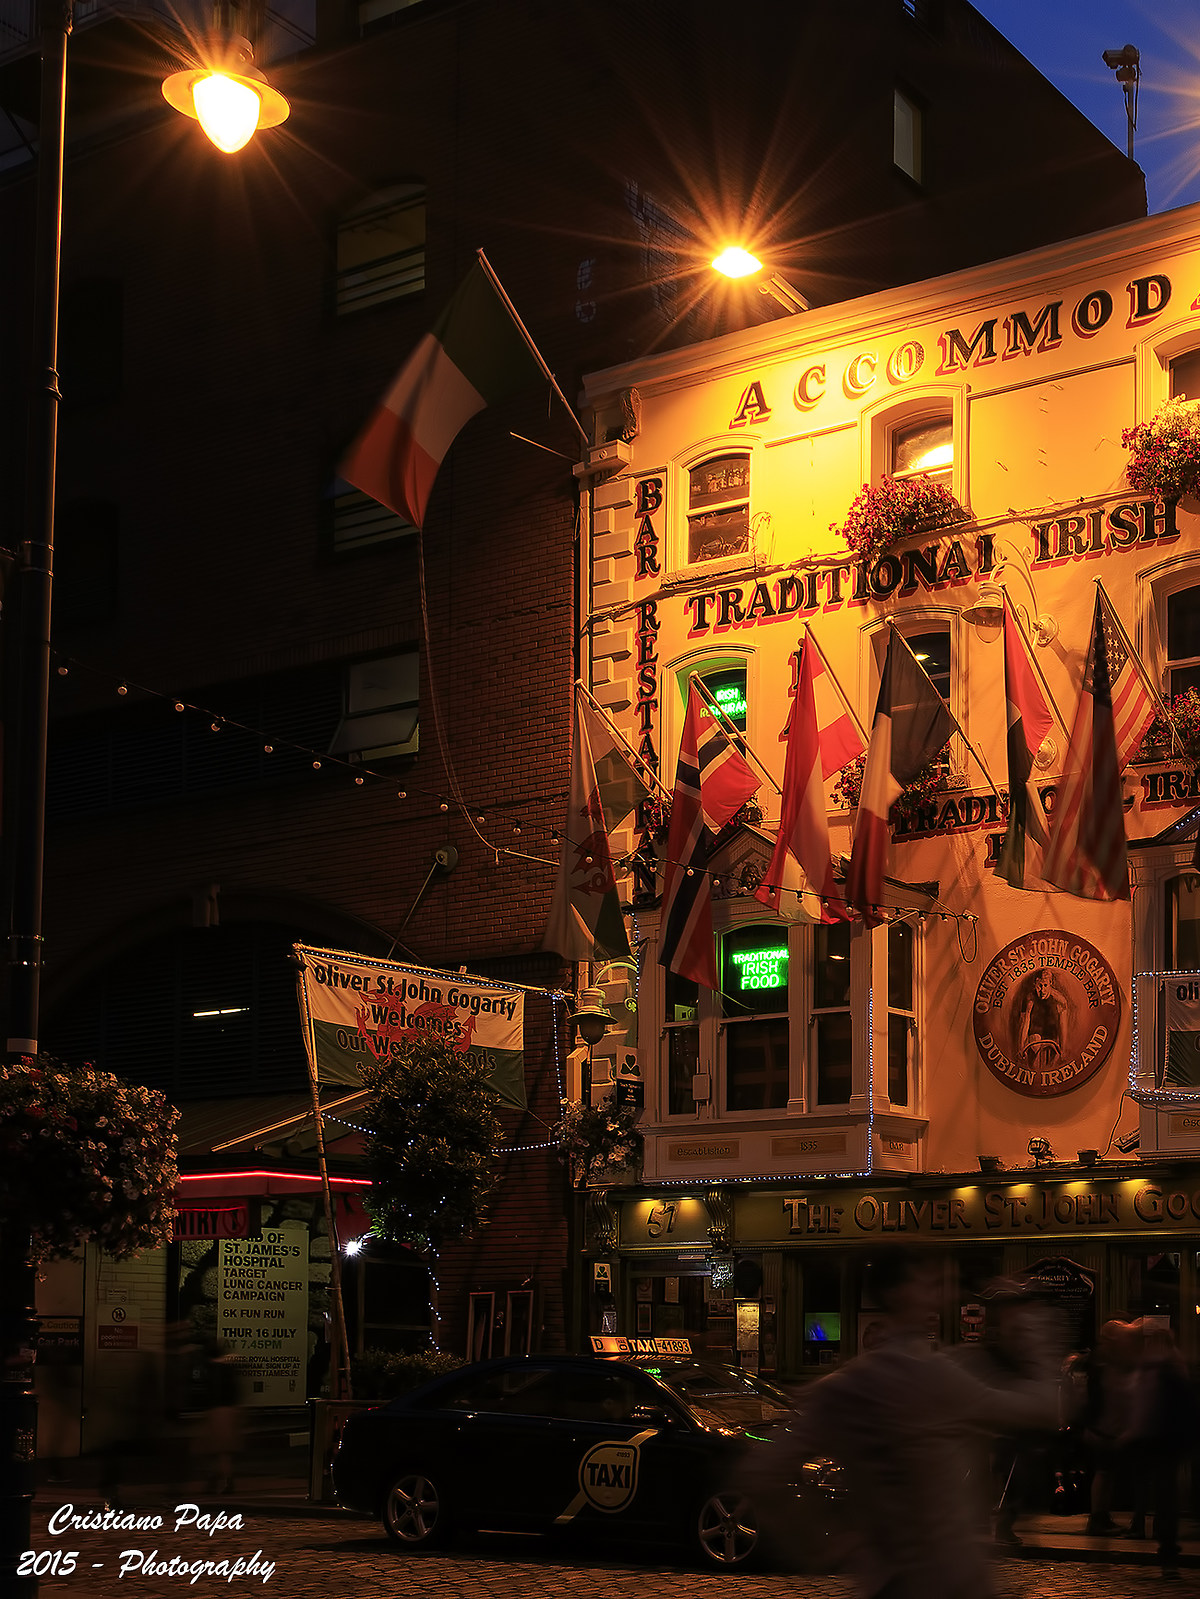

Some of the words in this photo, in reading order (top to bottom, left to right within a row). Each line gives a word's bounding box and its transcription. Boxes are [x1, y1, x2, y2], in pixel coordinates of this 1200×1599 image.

[634, 477, 663, 582] BAR
[1030, 500, 1182, 571] IRISH
[715, 687, 739, 702] IRISH
[732, 948, 790, 965] TRADITIONAL
[742, 960, 778, 976] IRISH
[975, 957, 1010, 1014] OLIVER
[1008, 944, 1027, 964] ST
[1029, 938, 1070, 957] JOHN
[1070, 944, 1116, 1007] GOGARTY
[741, 974, 780, 990] FOOD
[992, 981, 1010, 1009] EST
[1008, 958, 1036, 983] 1835
[1037, 956, 1087, 982] TEMPLE
[1083, 979, 1099, 1009] BAR
[314, 964, 371, 992] Oliver
[447, 988, 517, 1021] Gogarty
[370, 1004, 463, 1037] Welcomes
[337, 1028, 367, 1053] Our
[978, 1032, 1037, 1087] DUBLIN
[1040, 1024, 1109, 1087] IRELAND
[647, 1200, 682, 1239] 57
[783, 1194, 845, 1235] THE
[854, 1194, 972, 1233] OLIVER
[1033, 1188, 1121, 1231] JOHN
[176, 1208, 218, 1235] NTRY
[267, 1232, 285, 1243] OF
[224, 1242, 243, 1254] ST.
[246, 1243, 301, 1257] JAMES'S
[223, 1255, 285, 1268] HOSPITAL
[223, 1267, 267, 1279] TARGET
[223, 1279, 254, 1290] LUNG
[257, 1280, 303, 1291] CANCER
[223, 1290, 285, 1302] CAMPAIGN
[222, 1308, 238, 1318] 6K
[240, 1309, 261, 1318] FUN
[263, 1309, 285, 1319] RUN
[46, 1321, 80, 1330] Caution
[222, 1327, 253, 1338] THUR
[255, 1327, 269, 1338] 16
[271, 1328, 297, 1339] JULY
[240, 1340, 283, 1350] 7.45PM
[628, 1338, 658, 1353] TAXI
[248, 1355, 269, 1363] ROYAL
[265, 1362, 282, 1370] SIGN
[292, 1362, 301, 1370] AT
[587, 1462, 632, 1489] TAXI
